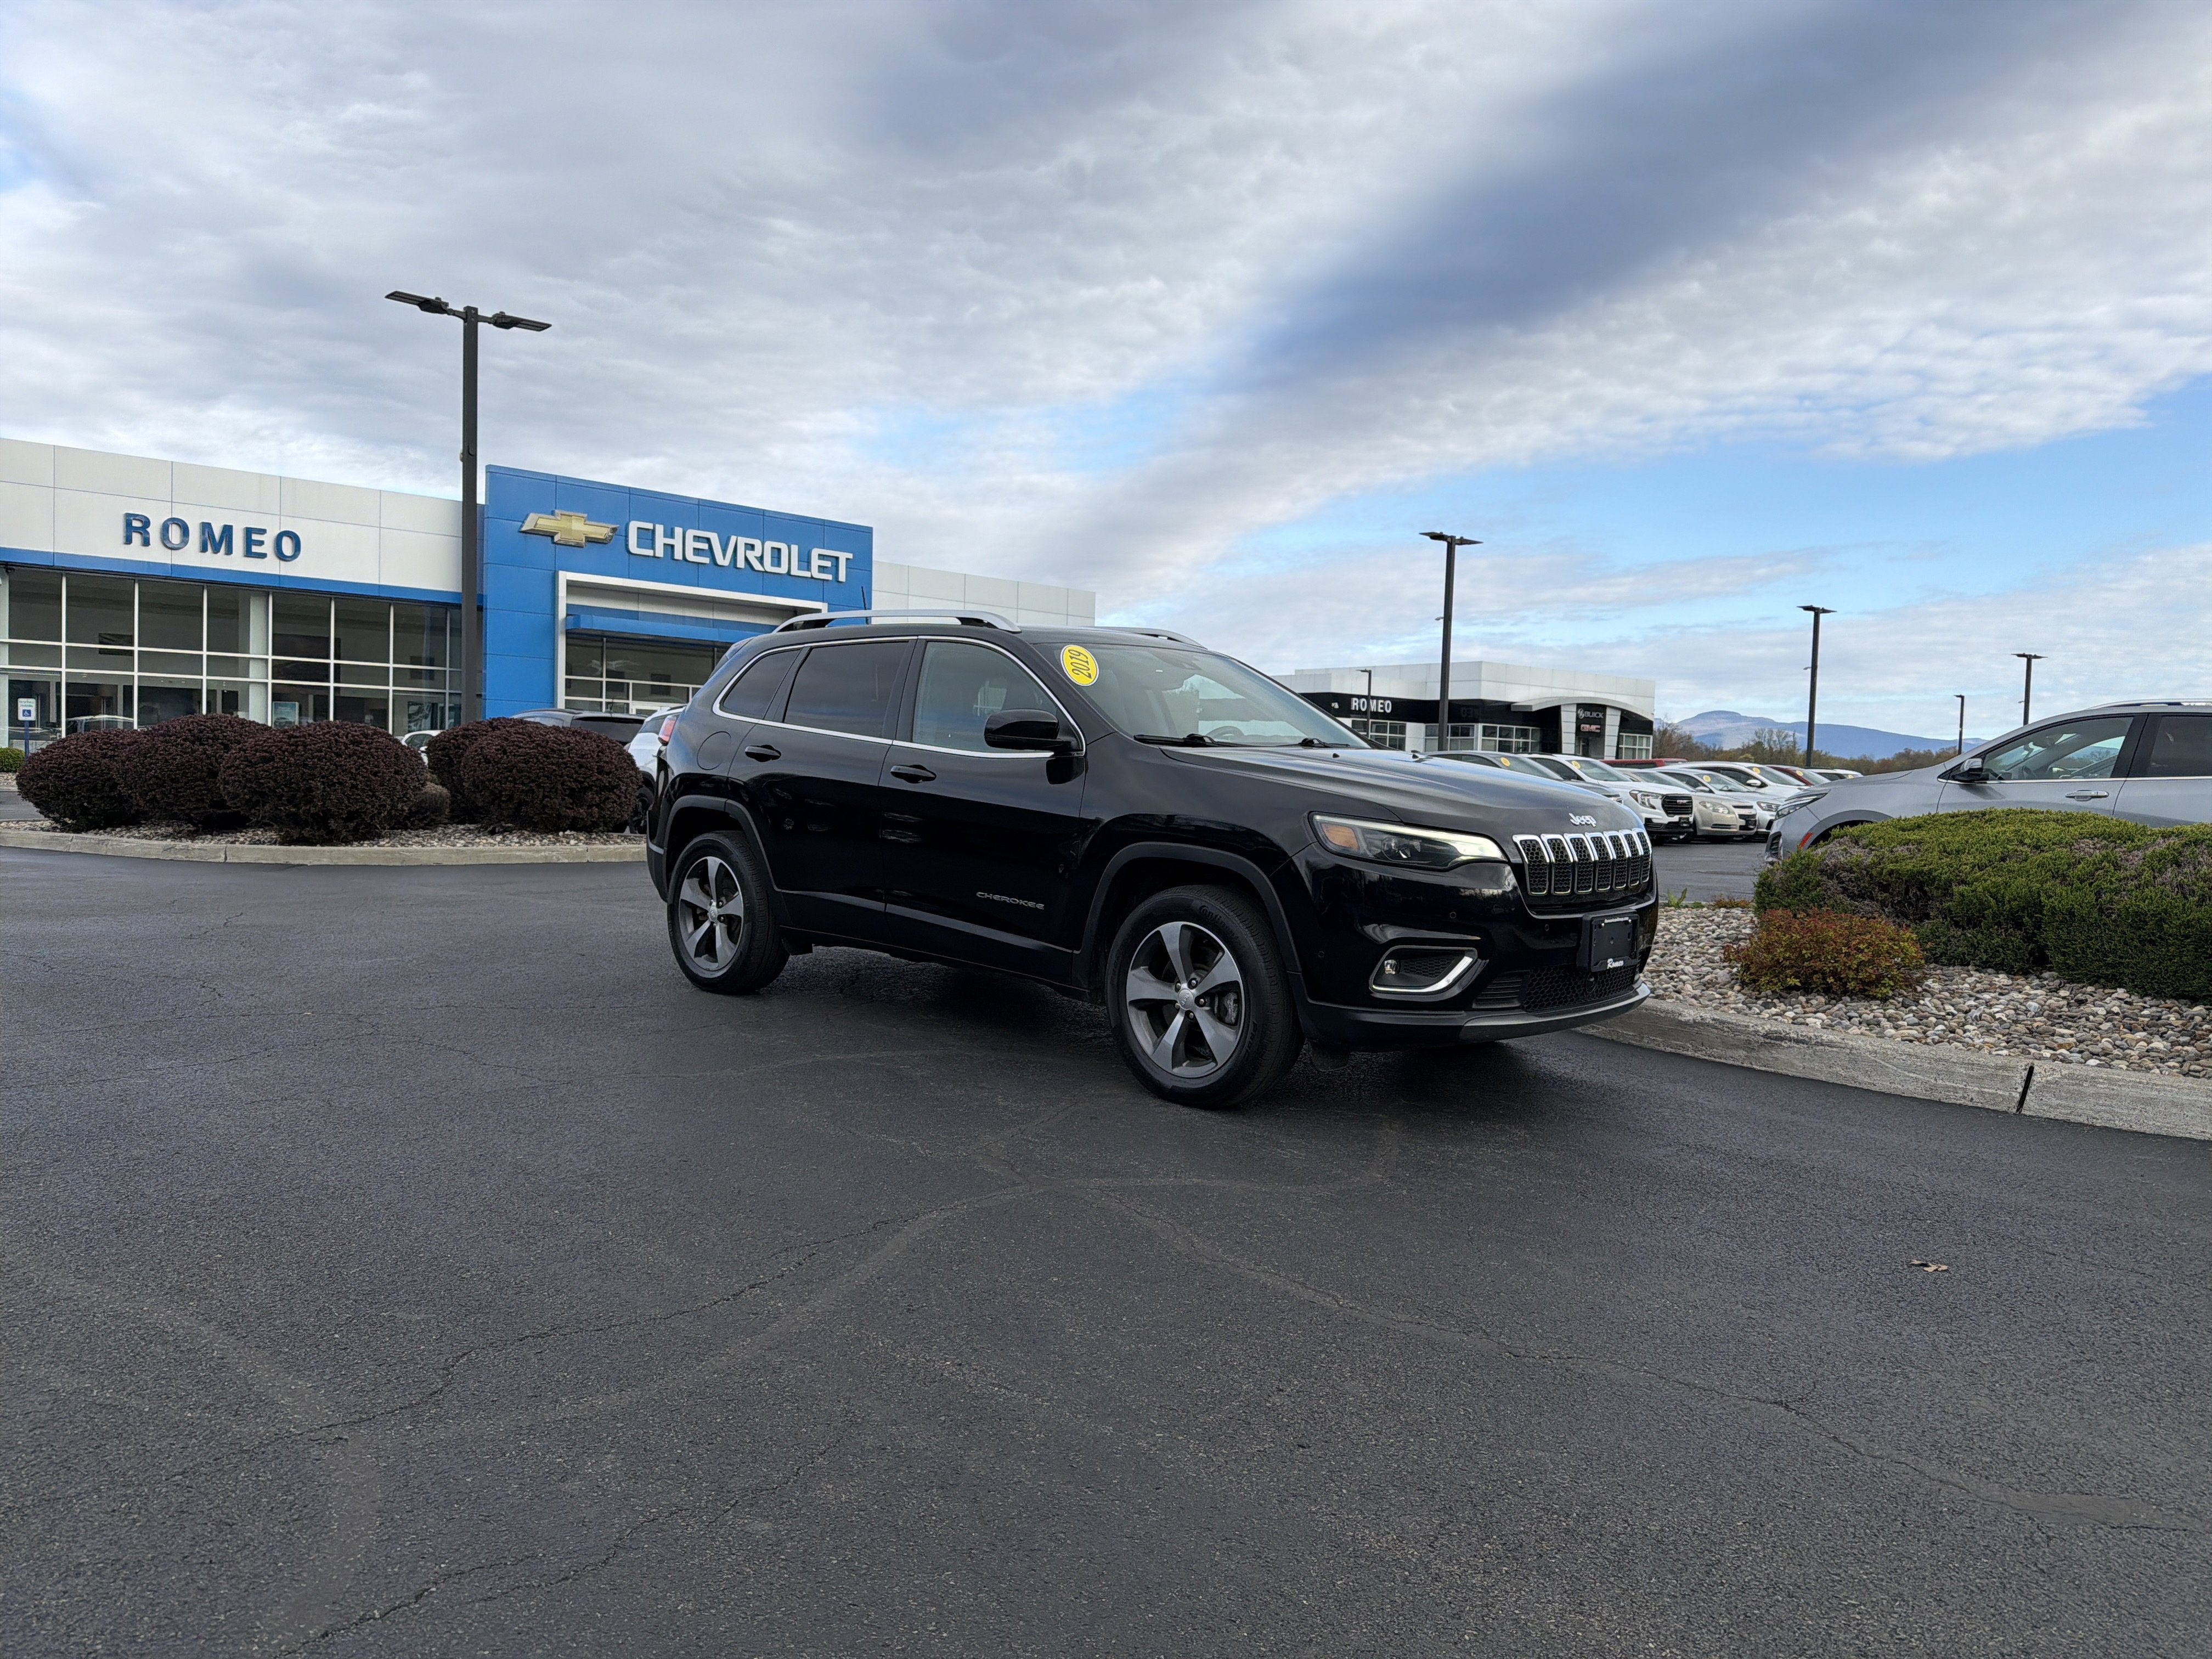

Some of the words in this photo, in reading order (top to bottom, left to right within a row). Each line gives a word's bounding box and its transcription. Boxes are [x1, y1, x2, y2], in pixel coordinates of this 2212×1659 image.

[123, 512, 301, 562] ROMEO
[628, 520, 853, 582] CHEVROLET
[1068, 649, 1092, 679] 2019
[1351, 697, 1392, 713] ROMEO
[1568, 812, 1597, 827] Jeep
[975, 891, 1045, 910] CHEROKEE
